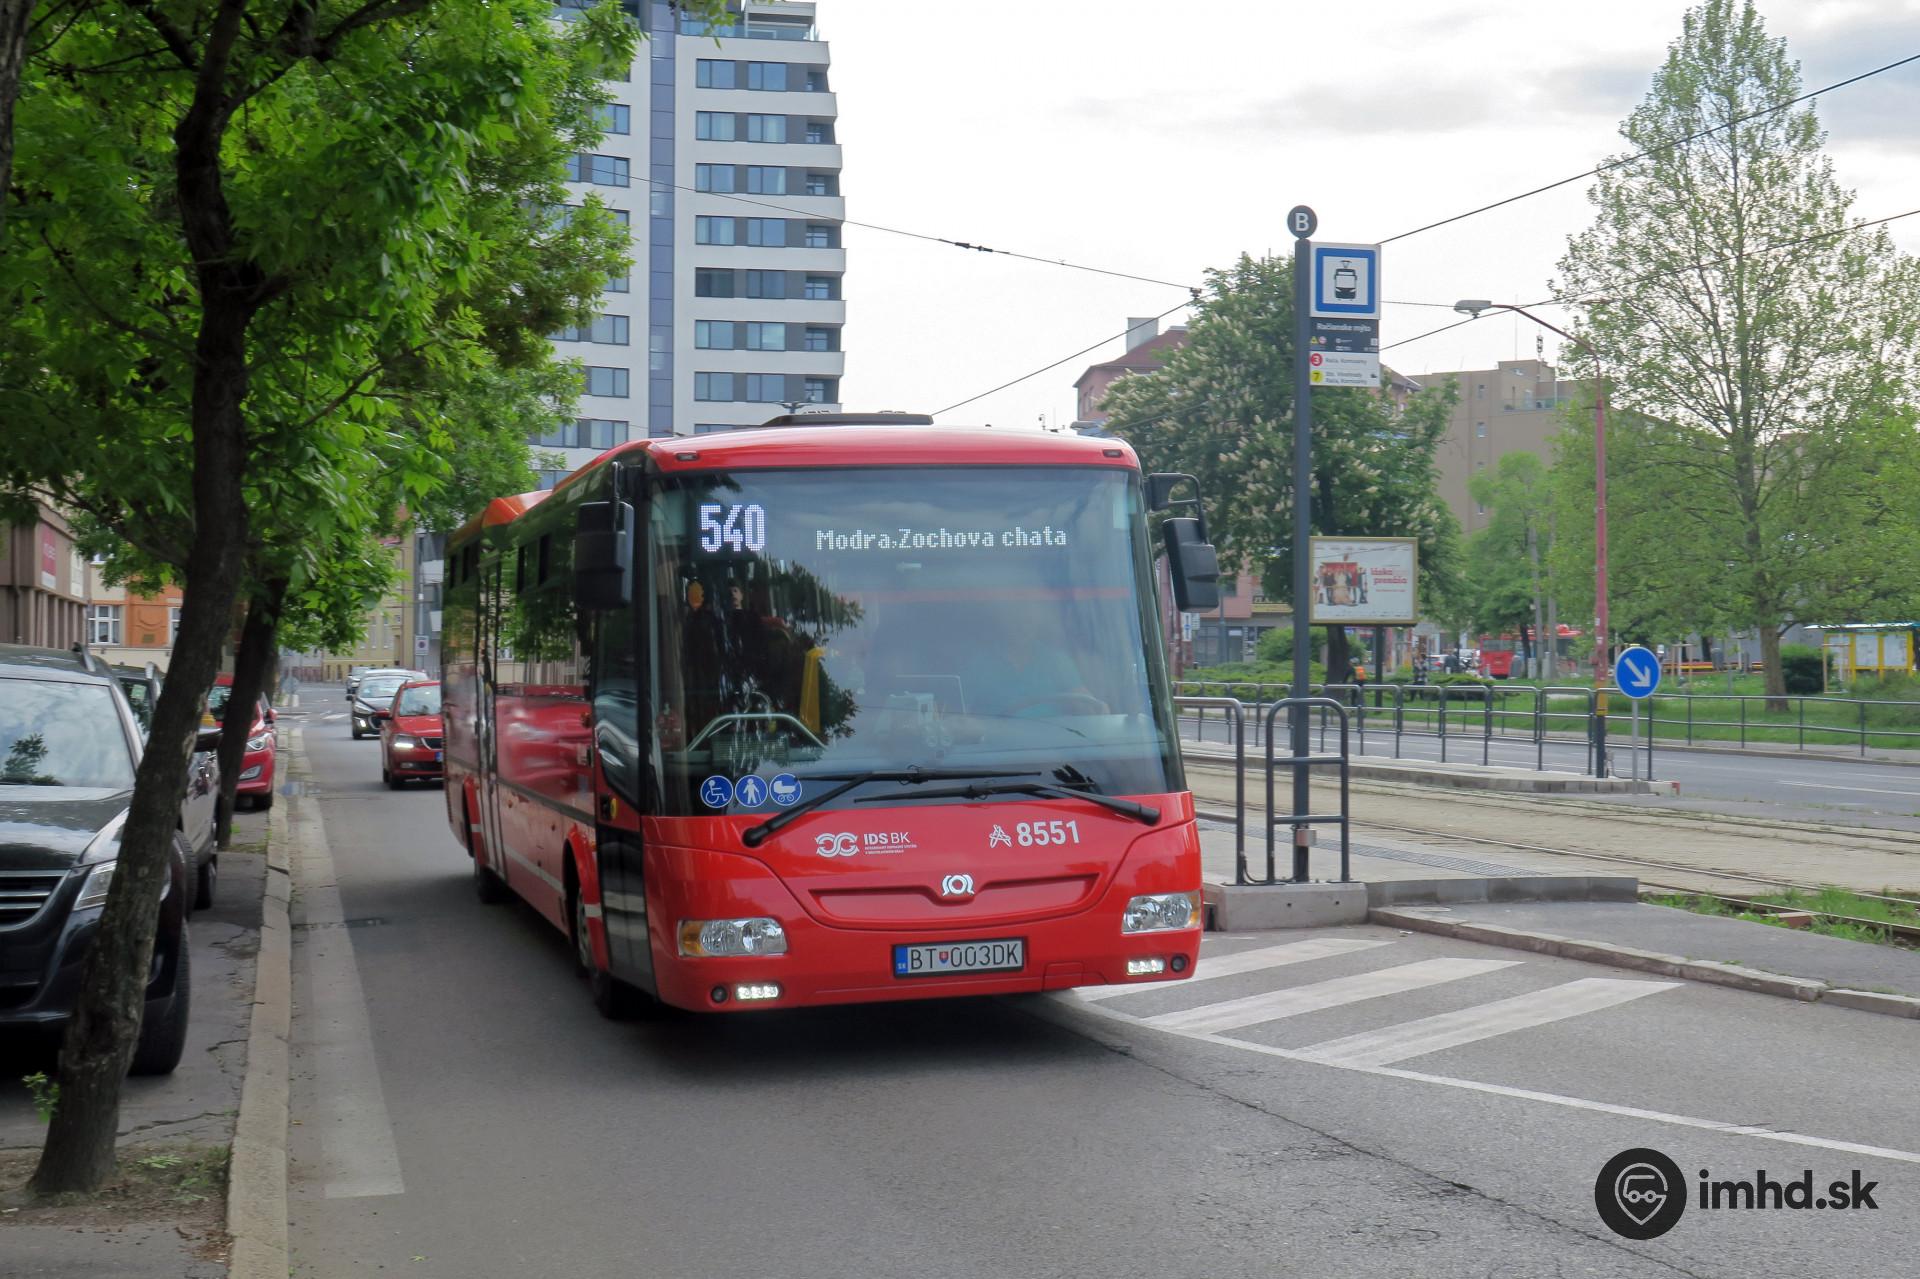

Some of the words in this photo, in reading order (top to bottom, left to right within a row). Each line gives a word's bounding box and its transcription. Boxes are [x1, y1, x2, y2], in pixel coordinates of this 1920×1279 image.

[1295, 212, 1309, 232] B
[1313, 355, 1320, 365] 3
[700, 504, 766, 552] 540
[1001, 526, 1067, 547] chata
[864, 832, 888, 845] IDS
[890, 831, 911, 844] BK
[1016, 820, 1080, 847] 8551
[910, 948, 937, 970] BT
[950, 943, 1019, 968] 003DK
